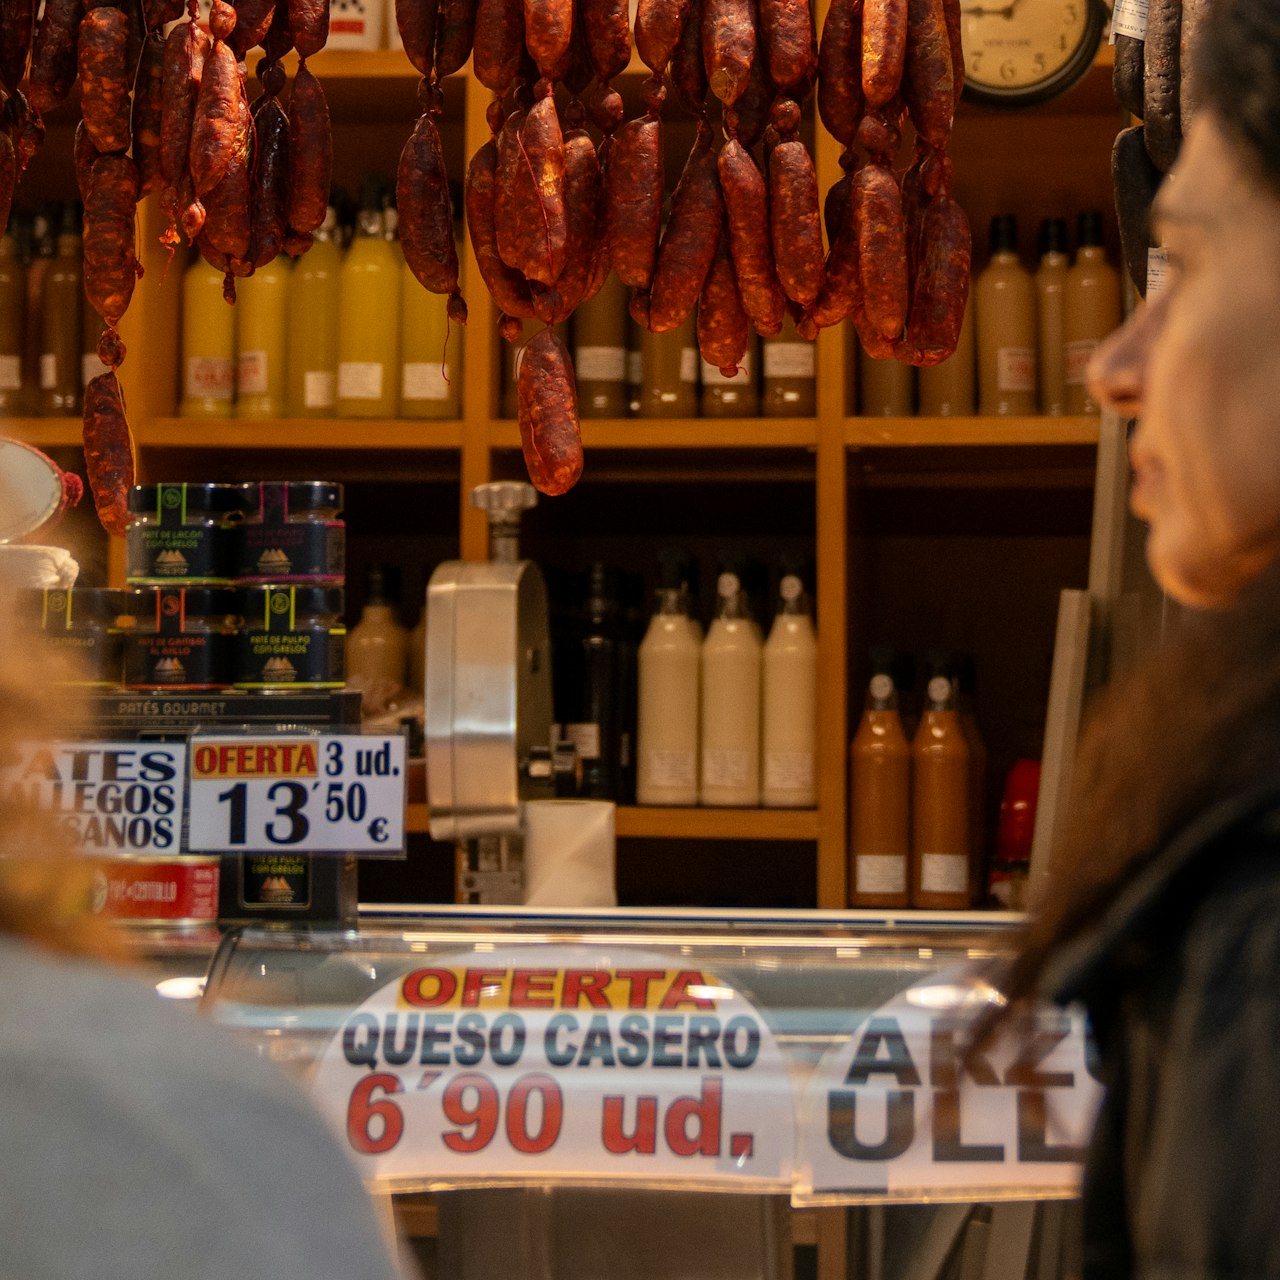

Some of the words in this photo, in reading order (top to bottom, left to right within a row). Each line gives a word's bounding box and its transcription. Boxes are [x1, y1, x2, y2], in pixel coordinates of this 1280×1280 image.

[163, 702, 226, 714] GOURMET
[194, 744, 317, 774] OFERTA
[325, 742, 344, 776] 3
[356, 742, 399, 776] ud.
[367, 816, 389, 842] €
[401, 967, 718, 1011] OFERTA
[342, 1013, 527, 1072] QUESO
[544, 1013, 761, 1070] CASERO
[601, 1076, 755, 1159] ud.
